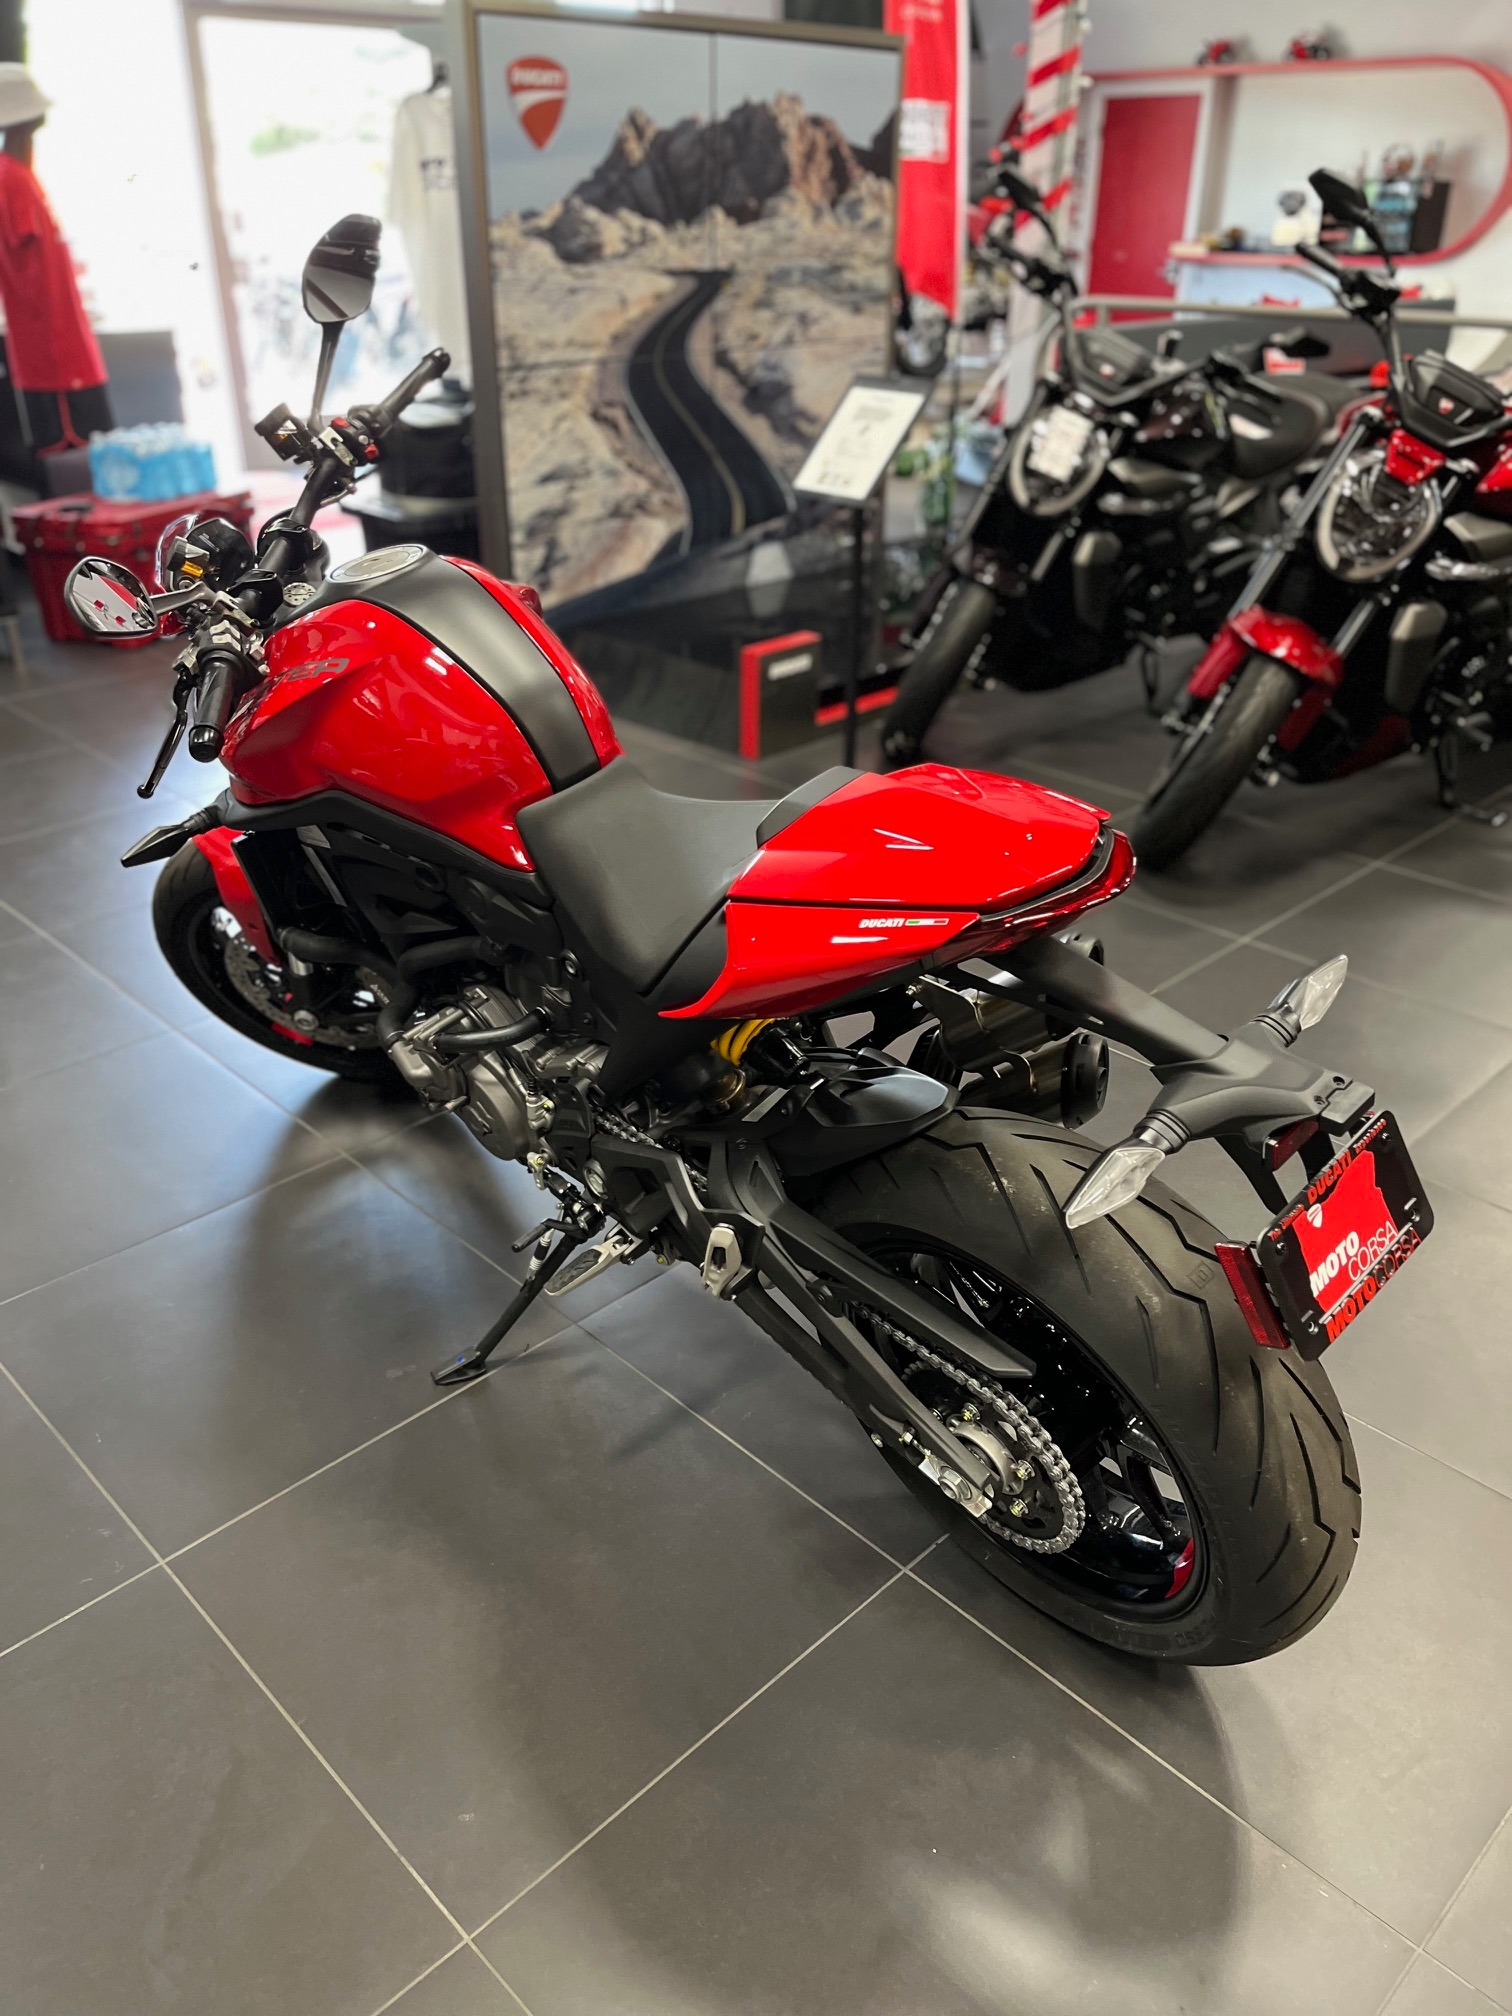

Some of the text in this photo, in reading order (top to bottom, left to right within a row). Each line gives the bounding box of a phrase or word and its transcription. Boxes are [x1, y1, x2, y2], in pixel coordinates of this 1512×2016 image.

[858, 917, 905, 929] DUCATI
[1268, 1228, 1282, 1241] The
[1307, 1151, 1351, 1205] DUCATI
[1309, 1231, 1360, 1298] MOTO
[1347, 1220, 1399, 1282] CORSA
